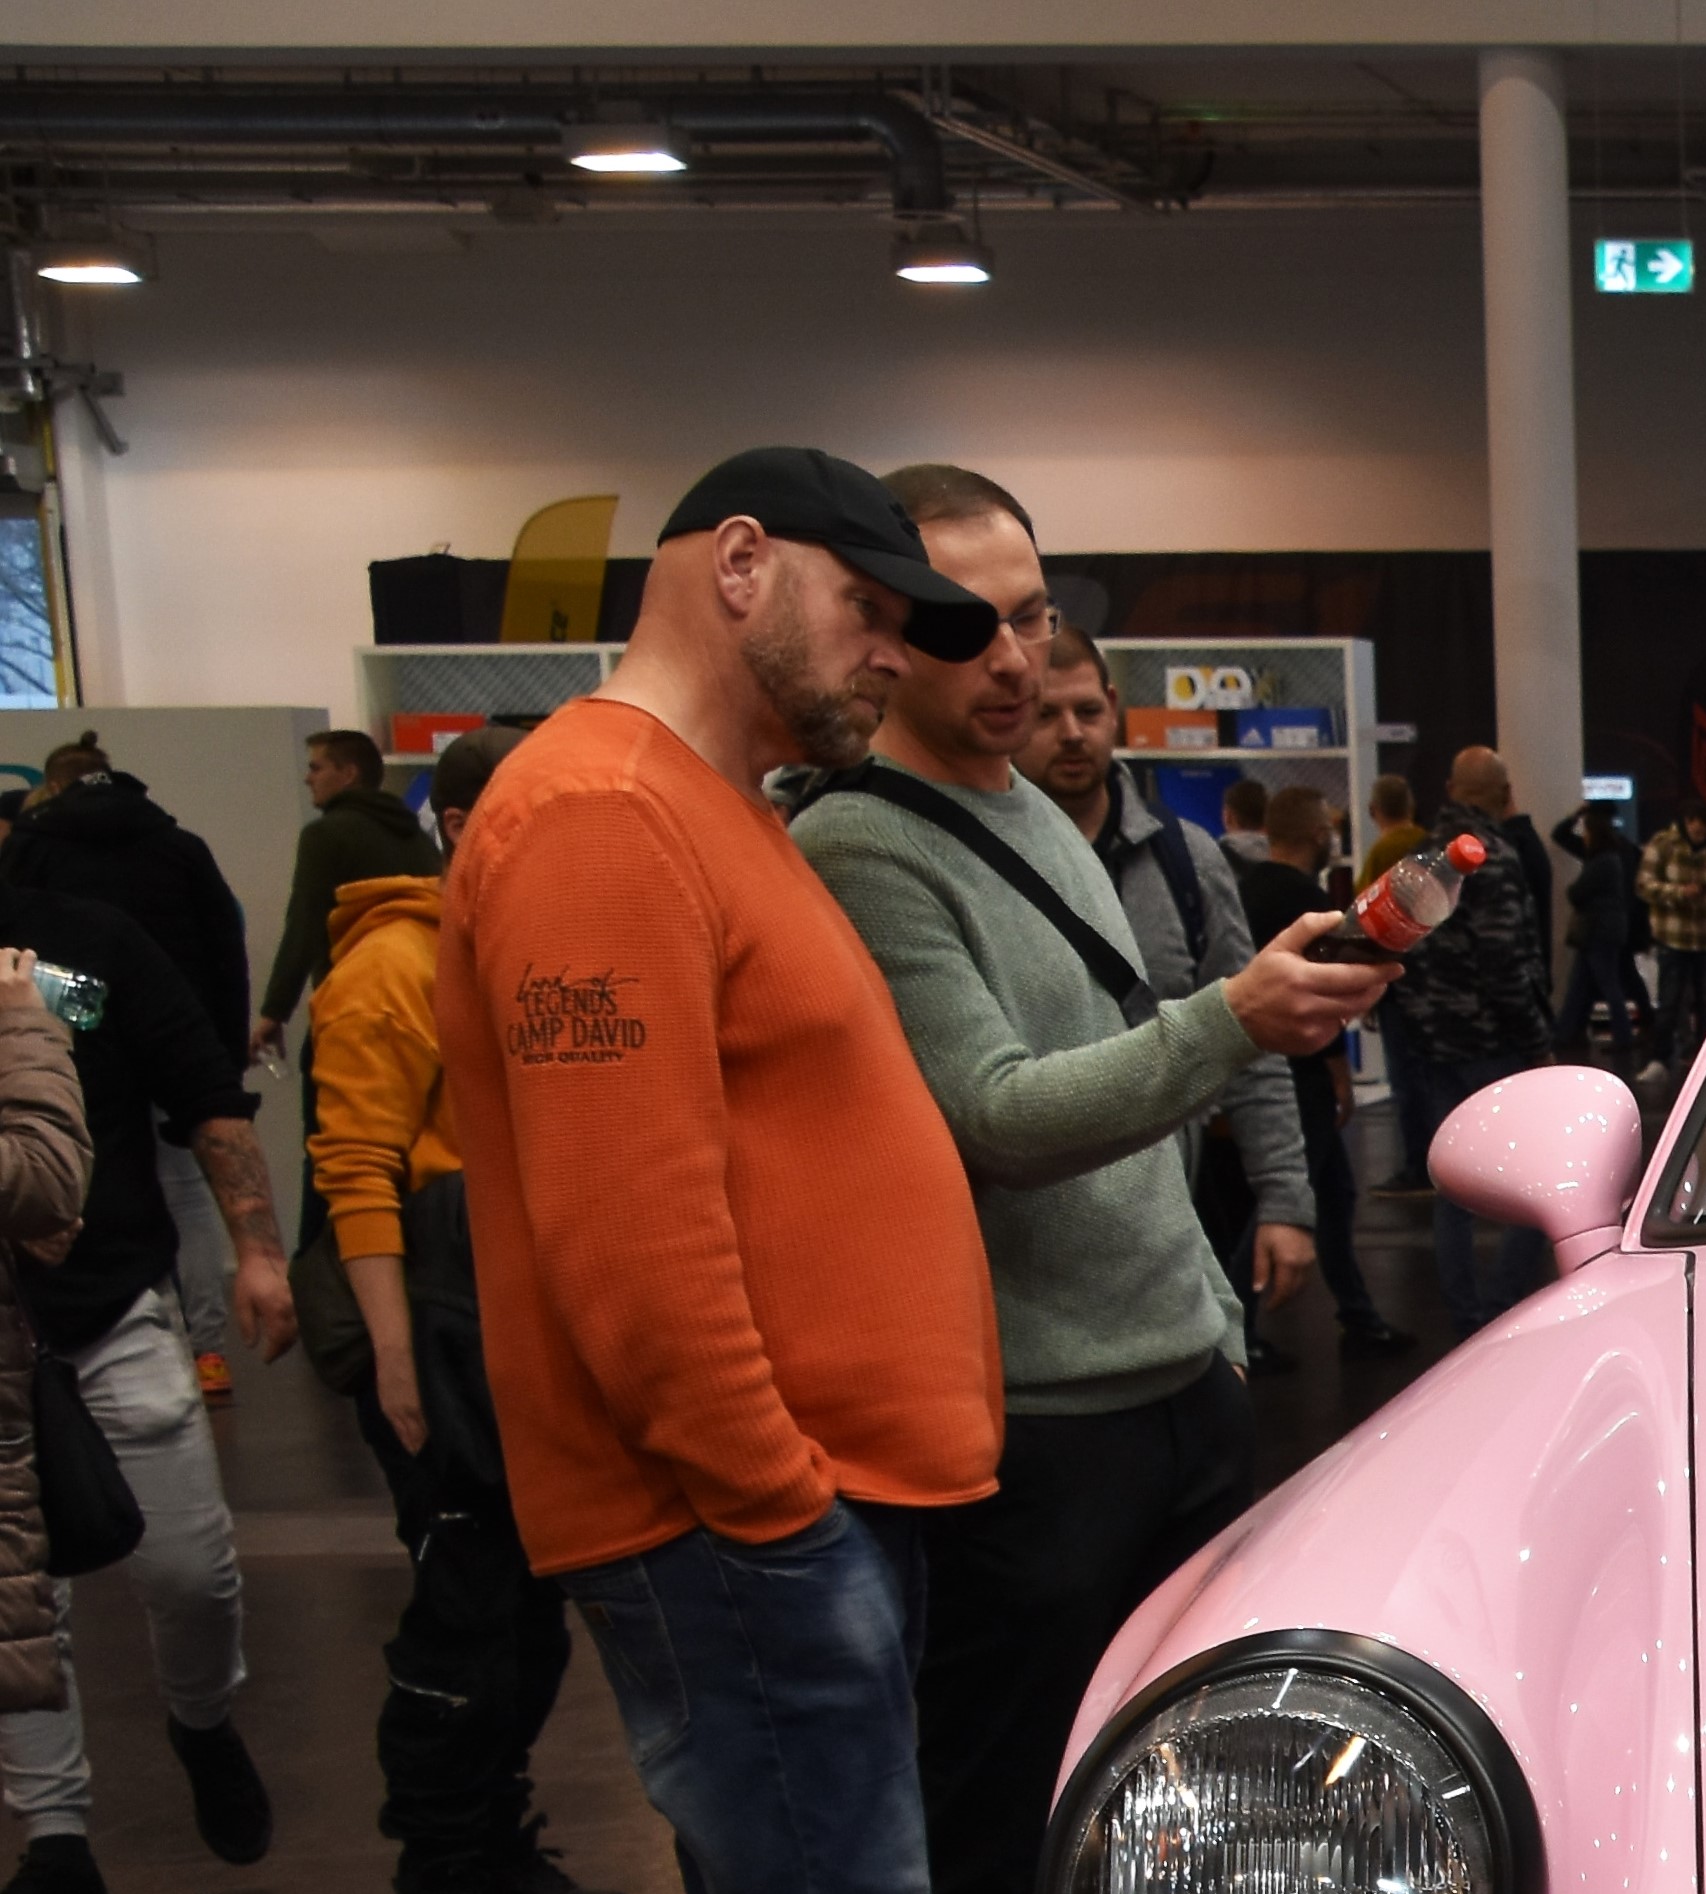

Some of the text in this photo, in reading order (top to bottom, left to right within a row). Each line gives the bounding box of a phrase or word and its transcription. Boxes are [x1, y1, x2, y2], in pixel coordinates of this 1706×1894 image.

[522, 987, 619, 1019] LEGENDS
[506, 1016, 647, 1057] CAMP DAVID
[558, 1051, 625, 1064] QUALITY
